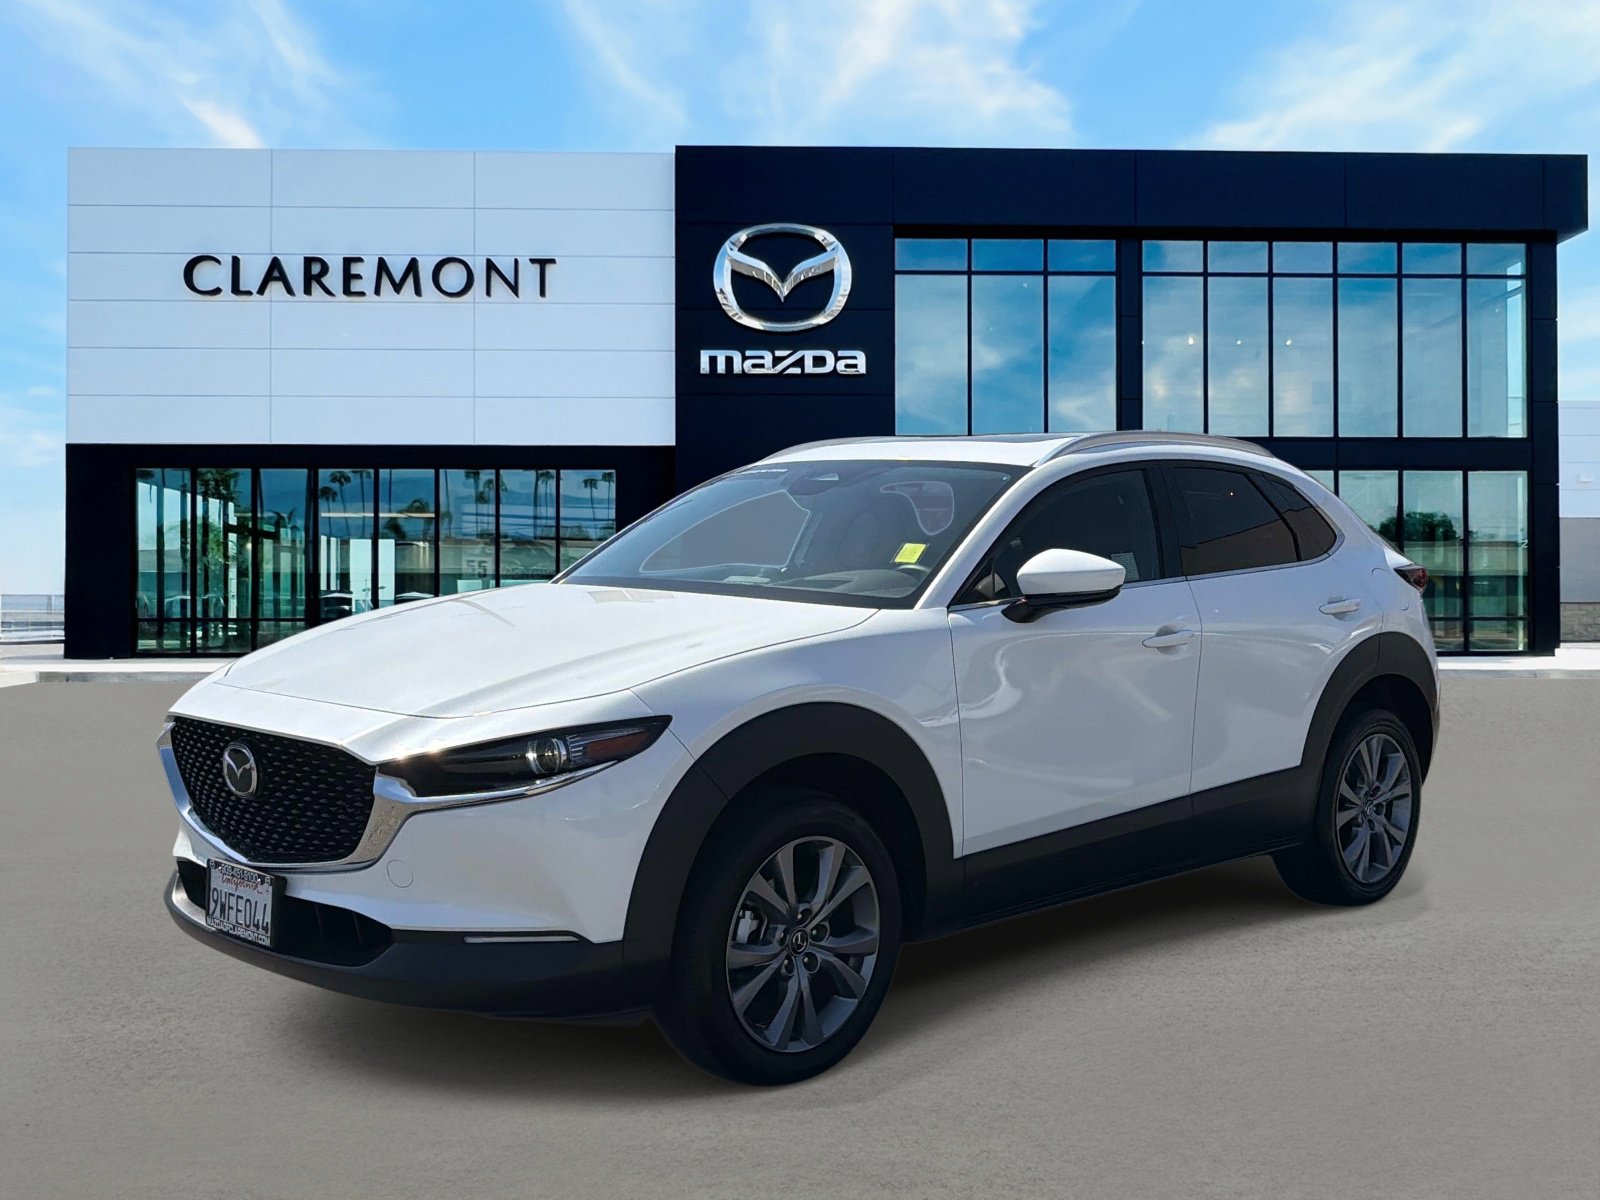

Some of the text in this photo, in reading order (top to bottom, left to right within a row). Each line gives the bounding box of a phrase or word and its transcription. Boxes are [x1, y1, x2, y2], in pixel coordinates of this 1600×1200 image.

[184, 255, 557, 299] CLAREMONT
[699, 349, 867, 376] mazda
[211, 888, 269, 934] 9WFE044
